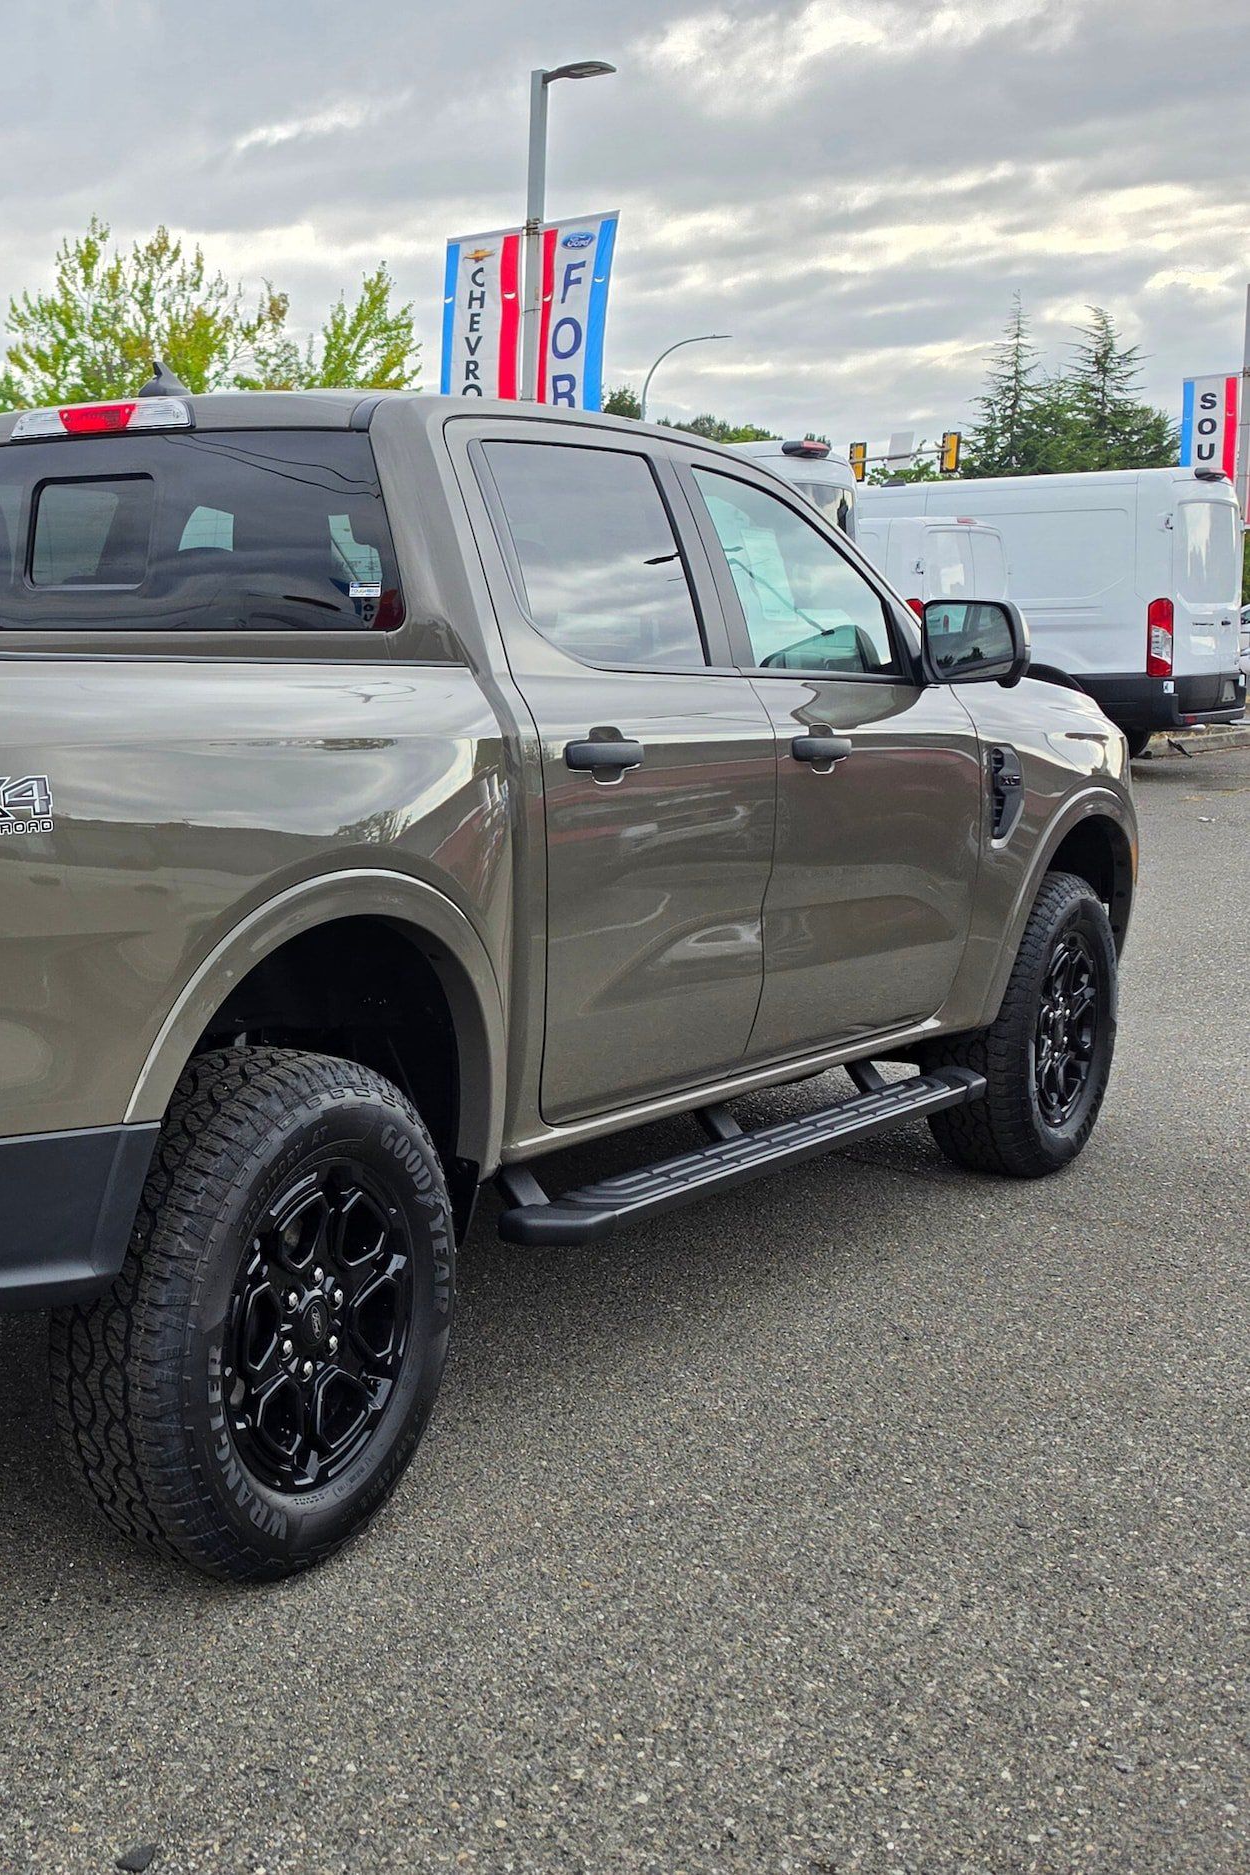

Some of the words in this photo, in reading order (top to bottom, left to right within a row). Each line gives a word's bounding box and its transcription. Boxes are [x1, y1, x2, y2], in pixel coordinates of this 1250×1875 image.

[552, 260, 586, 409] FOR
[1196, 392, 1218, 461] SOU
[380, 1123, 450, 1314] GOODYEAR
[207, 1344, 289, 1541] WRANGLER
